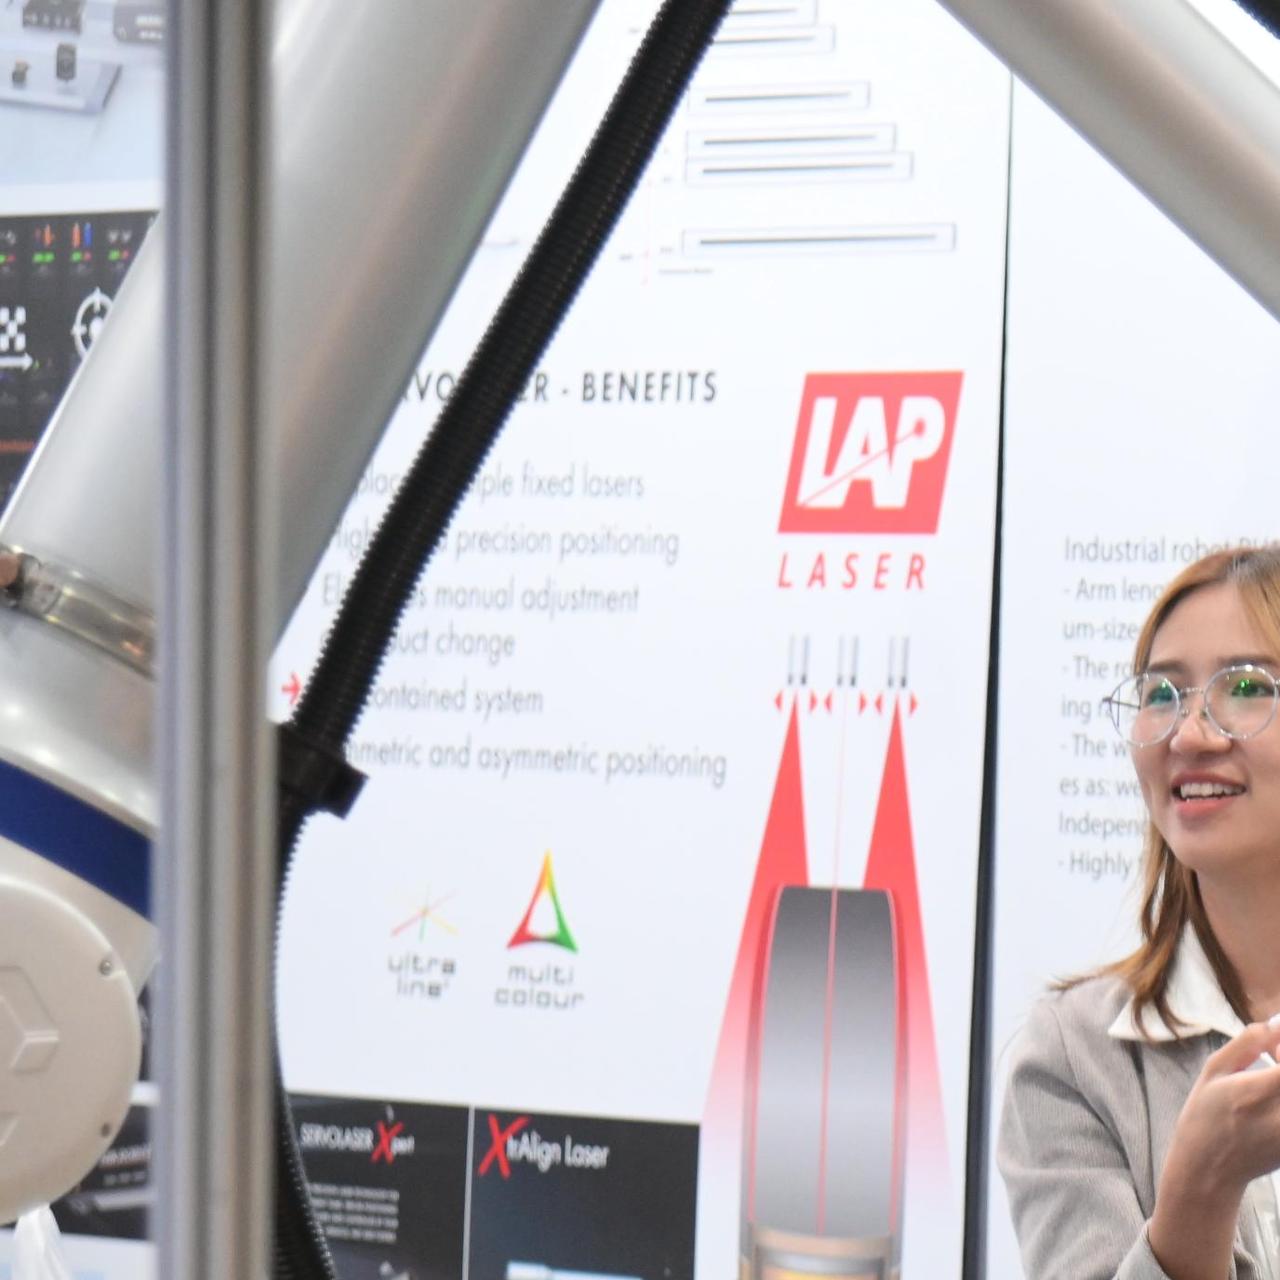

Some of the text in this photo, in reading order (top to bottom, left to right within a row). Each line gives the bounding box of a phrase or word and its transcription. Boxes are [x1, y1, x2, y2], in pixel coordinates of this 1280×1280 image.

[582, 372, 716, 402] BENEFITS
[796, 395, 946, 509] LAP
[522, 460, 575, 497] fixed
[582, 463, 644, 498] lasers
[455, 523, 551, 562] precision
[560, 525, 680, 567] positioning
[1065, 536, 1165, 563] Industrial
[778, 553, 926, 590] LASER
[434, 574, 515, 609] manual
[521, 574, 640, 621] adjustment
[1076, 577, 1116, 602] Arm
[435, 620, 516, 668] change
[1074, 655, 1109, 679] The
[473, 682, 544, 722] system
[1061, 694, 1092, 724] ing
[429, 731, 471, 768] and
[479, 740, 600, 778] asymmetric
[606, 743, 727, 788] positioning
[1072, 734, 1107, 758] The
[1069, 850, 1134, 880] Highly
[508, 963, 574, 985] multi
[494, 986, 585, 1010] colour
[564, 1133, 609, 1169] Laser
